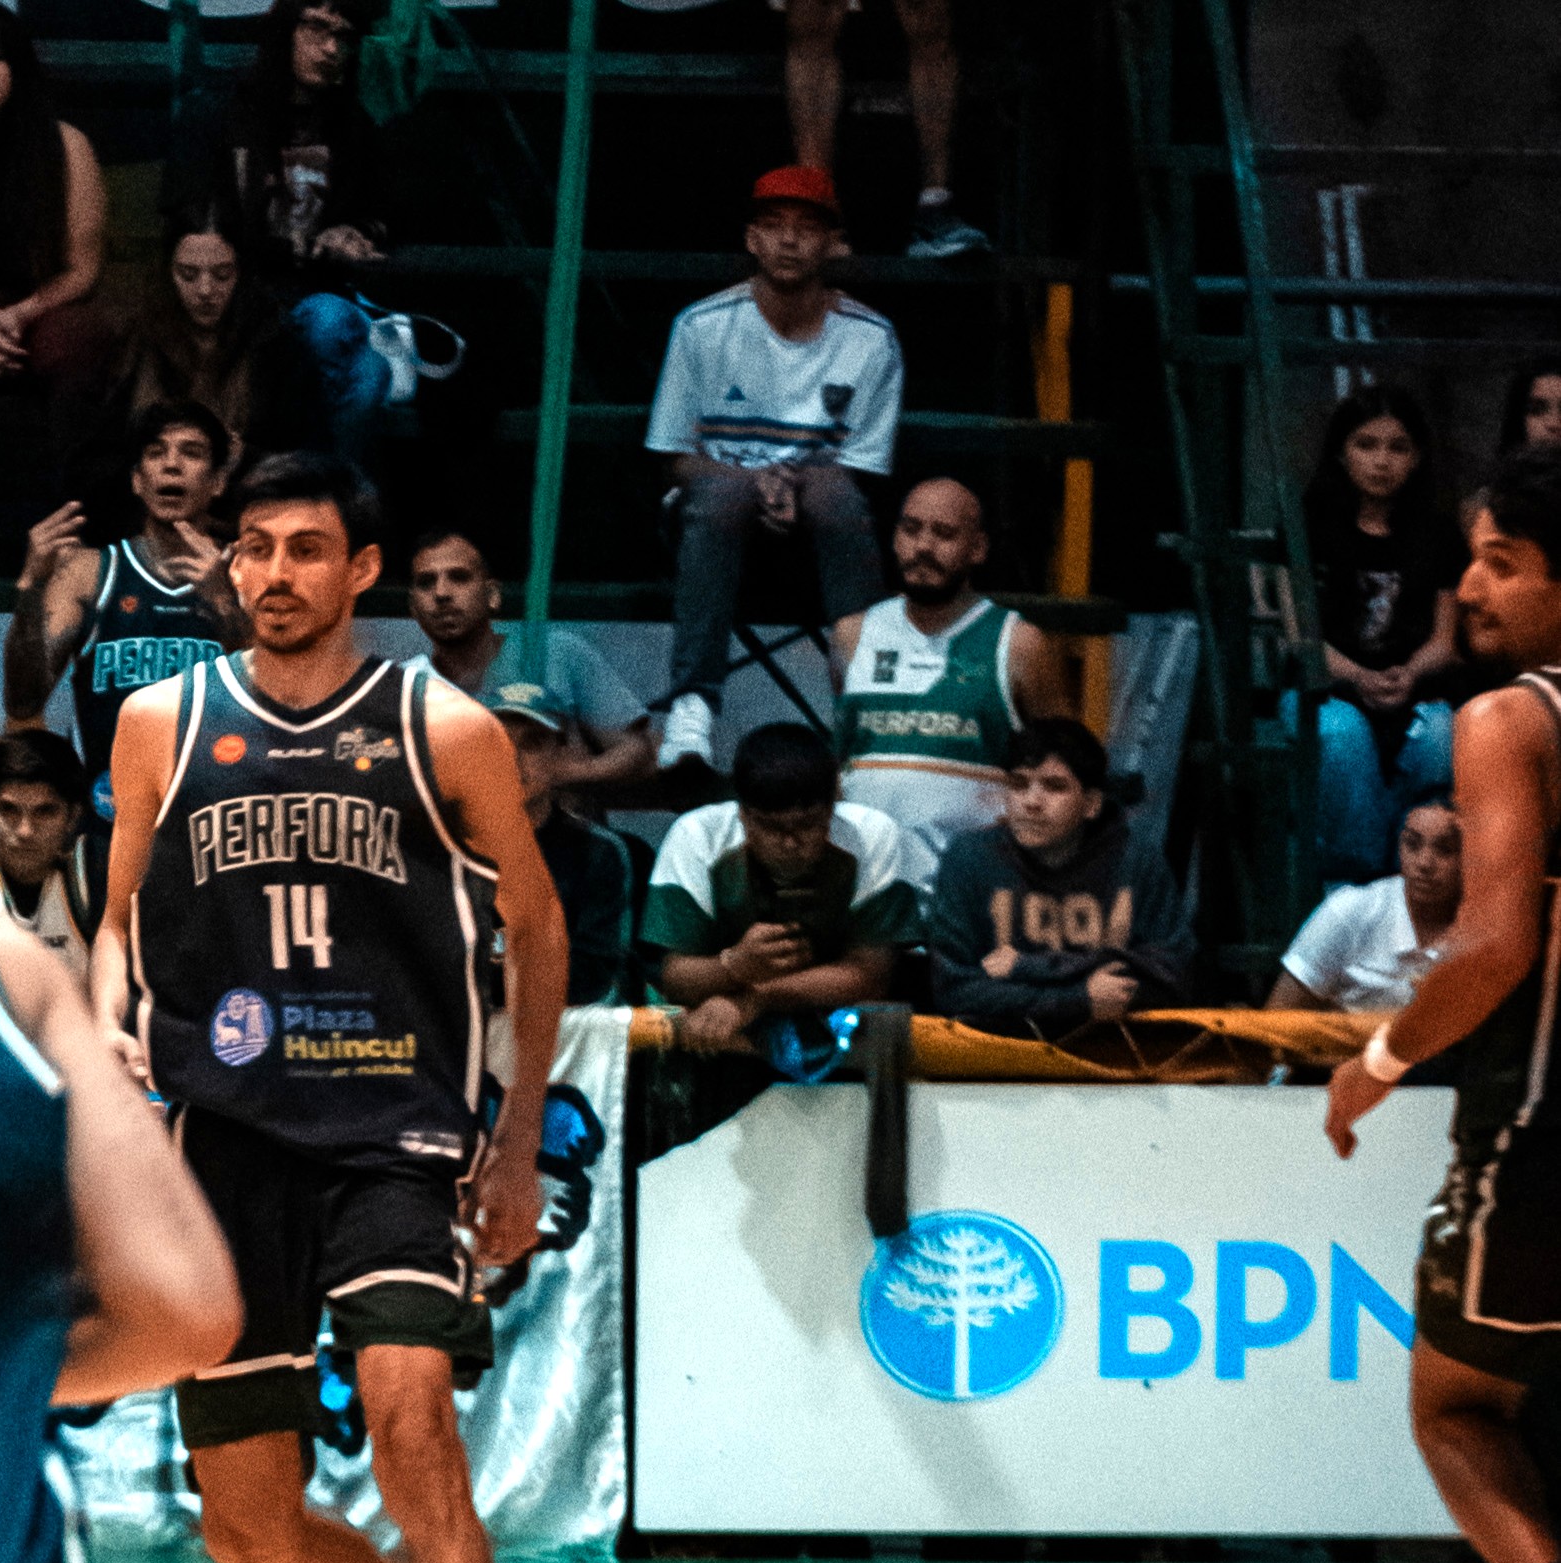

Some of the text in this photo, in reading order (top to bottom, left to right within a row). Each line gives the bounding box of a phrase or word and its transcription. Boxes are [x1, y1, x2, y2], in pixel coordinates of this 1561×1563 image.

[188, 792, 409, 885] PERFORA
[263, 883, 333, 970] 14
[282, 1004, 376, 1031] Plaza
[282, 1031, 417, 1060] Huincul
[1097, 1238, 1416, 1382] BPN
